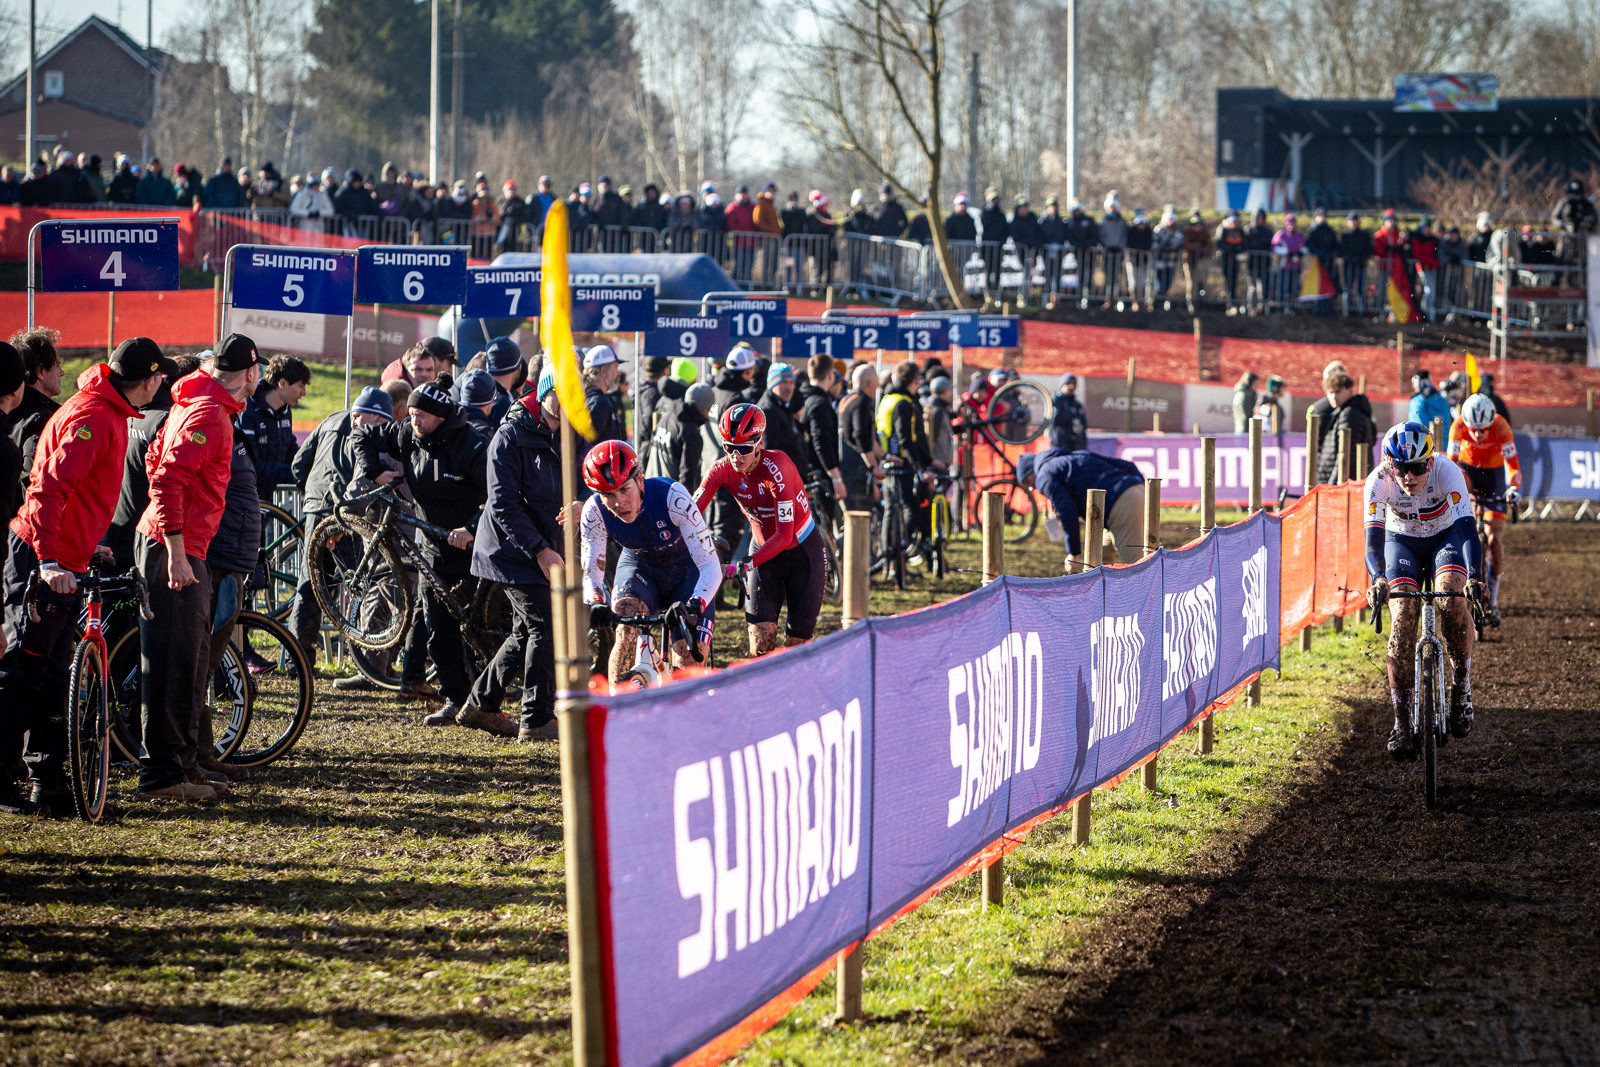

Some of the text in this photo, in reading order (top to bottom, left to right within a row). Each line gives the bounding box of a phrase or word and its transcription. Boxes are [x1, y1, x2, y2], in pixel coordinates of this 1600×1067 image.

[61, 229, 158, 244] SHIMANO
[99, 251, 127, 287] 4
[252, 253, 337, 272] SHIMANO
[373, 252, 451, 266] SHIMANO
[403, 271, 425, 302] 6
[474, 271, 544, 284] SHIMANO
[282, 274, 305, 307] 5
[576, 289, 642, 301] SHIMANO
[505, 288, 522, 315] 7
[601, 304, 621, 330] 8
[656, 317, 719, 329] SHIMANO
[732, 312, 765, 337] 10
[846, 316, 890, 327] IMANO
[792, 323, 846, 334] SHIMANO
[853, 327, 879, 348] 12
[948, 323, 961, 342] 4
[977, 327, 1002, 346] 15
[679, 331, 698, 356] 9
[805, 335, 832, 357] 11
[903, 330, 931, 350] 13
[1120, 446, 1308, 489] SHIMAN
[1569, 450, 1600, 489] SH
[674, 496, 700, 522] CIC
[779, 507, 793, 518] 34
[947, 631, 1043, 828] SHIMANO
[673, 697, 862, 979] SHIMANO
